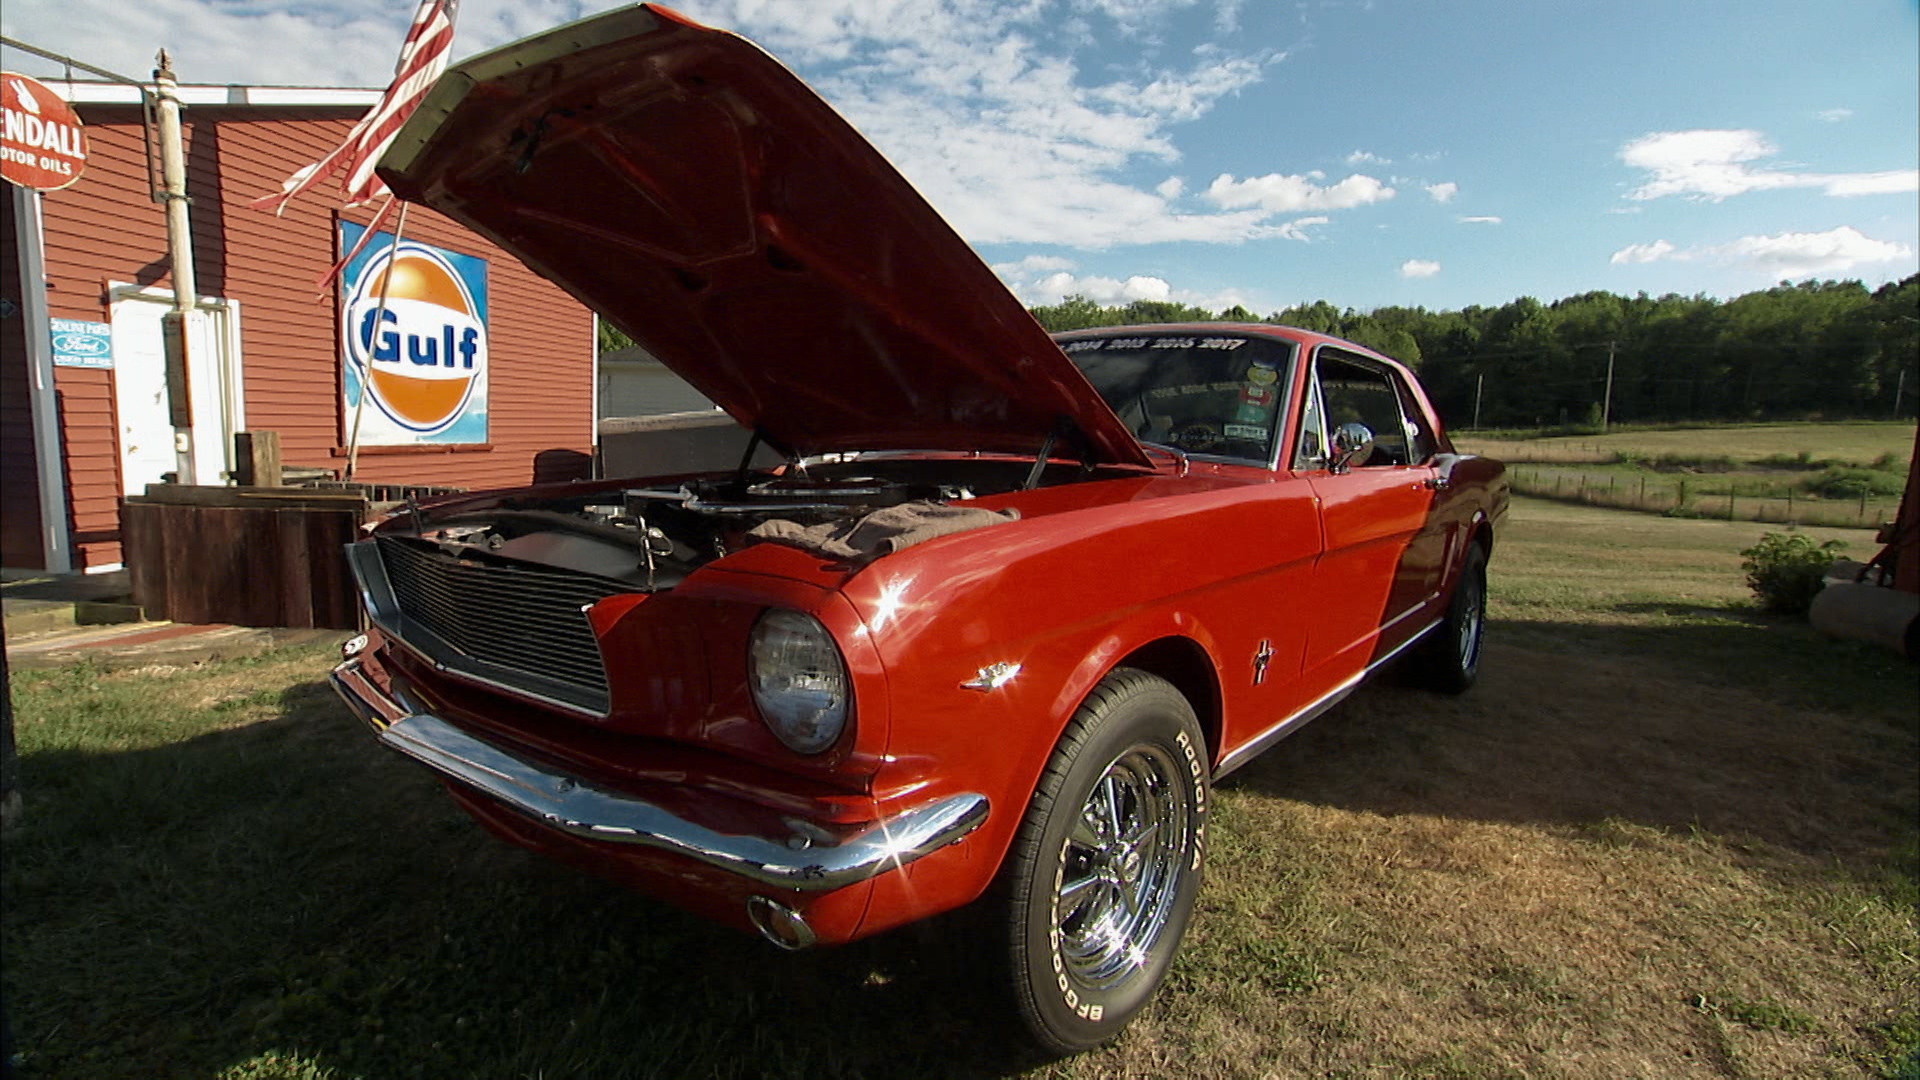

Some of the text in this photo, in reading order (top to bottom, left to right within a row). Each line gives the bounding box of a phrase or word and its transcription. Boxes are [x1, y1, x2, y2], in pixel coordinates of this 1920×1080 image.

[39, 156, 72, 176] OILS
[63, 336, 98, 353] Ford
[360, 307, 479, 369] Gulf
[1197, 337, 1248, 351] 2017
